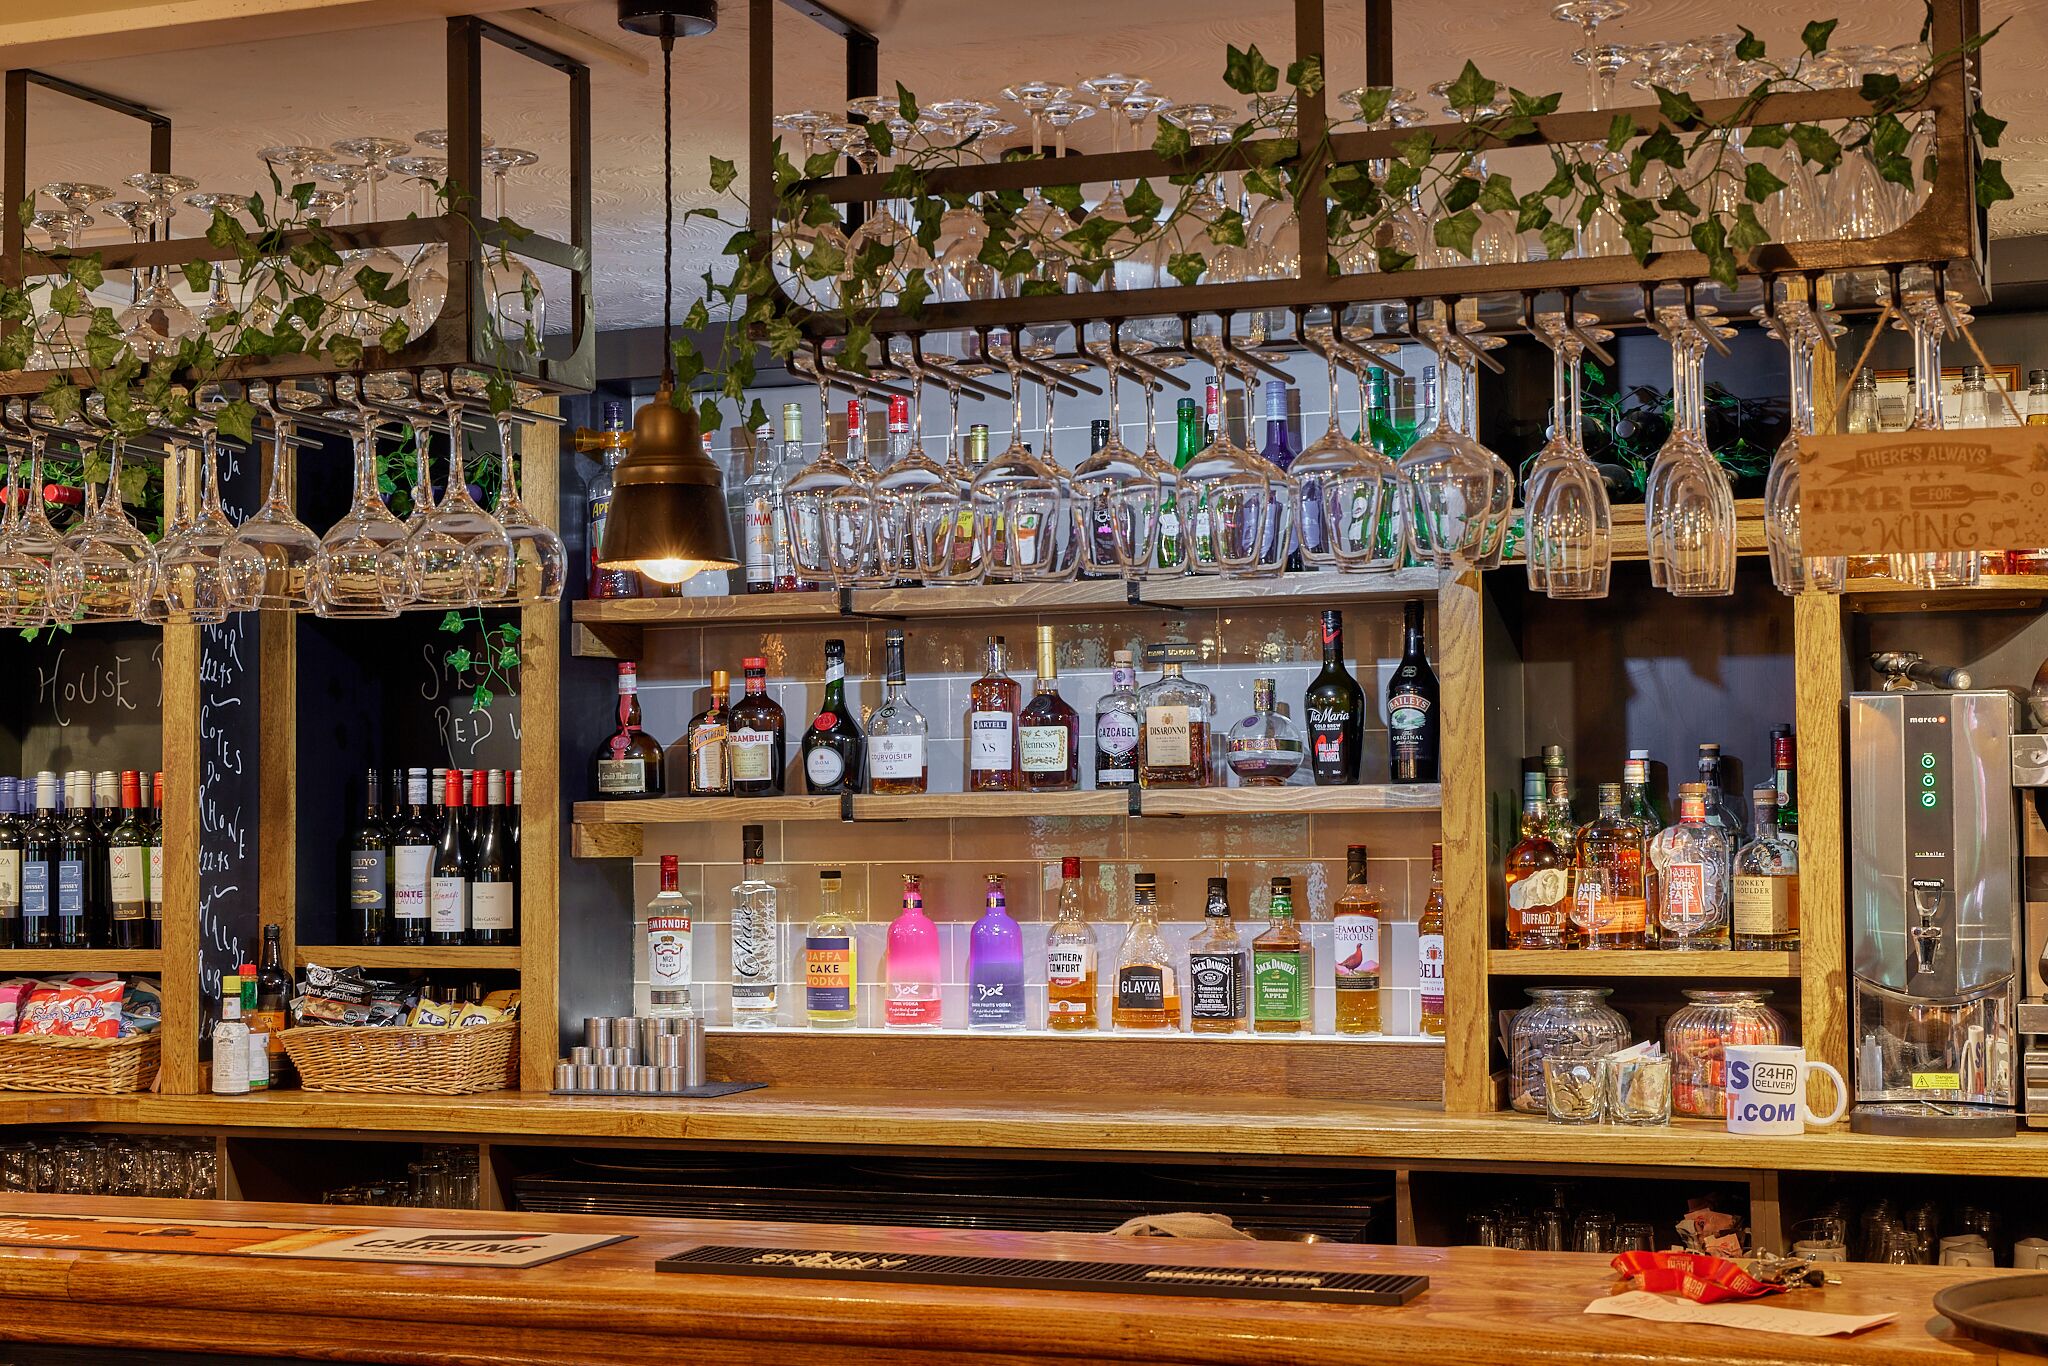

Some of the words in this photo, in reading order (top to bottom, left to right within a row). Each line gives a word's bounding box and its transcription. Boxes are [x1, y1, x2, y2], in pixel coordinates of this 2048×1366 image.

[1860, 446, 1923, 469] THERE'S
[1926, 446, 1988, 465] ALWAYS
[1805, 486, 1903, 512] TIME
[1928, 487, 1953, 501] FOR
[1872, 511, 1979, 550] WINE
[38, 648, 137, 727] HOUSE
[1390, 695, 1429, 710] BAILEYS
[434, 705, 494, 771] RED
[1098, 727, 1136, 738] CAZCABEL
[1150, 726, 1187, 736] DISARONNO
[730, 734, 770, 743] DRAMBUIE
[1023, 740, 1057, 749] Hennessy
[982, 742, 996, 753] VS
[1578, 882, 1602, 892] ABER
[648, 919, 689, 930] SMIRNOFF
[1521, 911, 1551, 925] BUFFALO
[1338, 925, 1374, 934] FAMOUS
[1338, 933, 1374, 941] GROUSE
[808, 951, 842, 961] JAFFA
[1048, 953, 1083, 963] SOUTHERN
[810, 964, 839, 974] CAKE
[1049, 963, 1081, 973] COMFORT
[1191, 961, 1207, 975] JACK
[1206, 958, 1231, 975] DANIEL'S
[1255, 961, 1271, 975] JACK
[1271, 958, 1297, 976] DANIEL'S
[807, 976, 844, 986] VODKA
[1121, 980, 1161, 994] GLAYVA
[305, 984, 321, 996] Pork
[322, 988, 362, 1003] Scratchings
[977, 983, 1004, 1001] Boë
[419, 1010, 446, 1025] KP
[1757, 1066, 1795, 1080] 24HR
[1755, 1079, 1795, 1090] DELIVERY
[354, 1238, 544, 1254] CARLING
